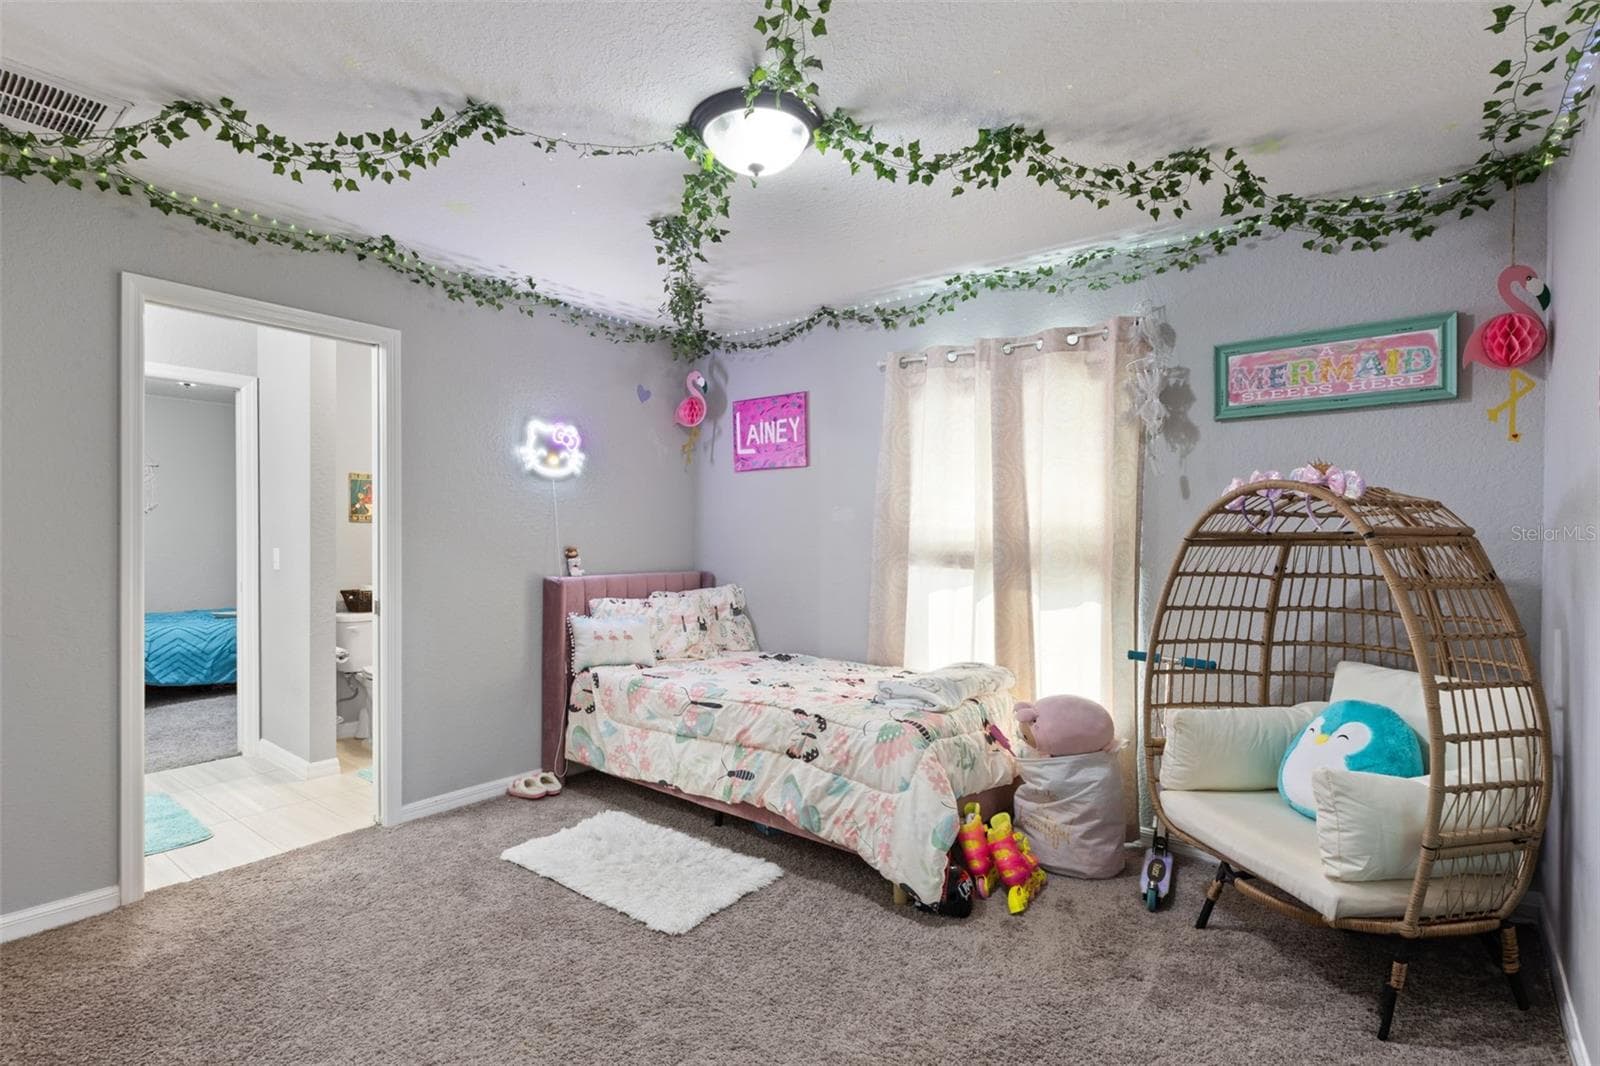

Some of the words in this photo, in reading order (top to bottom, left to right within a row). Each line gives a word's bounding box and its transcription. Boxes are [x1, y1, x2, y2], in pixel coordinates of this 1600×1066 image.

[1320, 346, 1334, 355] A
[1231, 347, 1434, 394] MERMAID
[1241, 384, 1334, 402] SLEEPS
[1346, 374, 1425, 393] HERE
[735, 411, 800, 455] LAINEY
